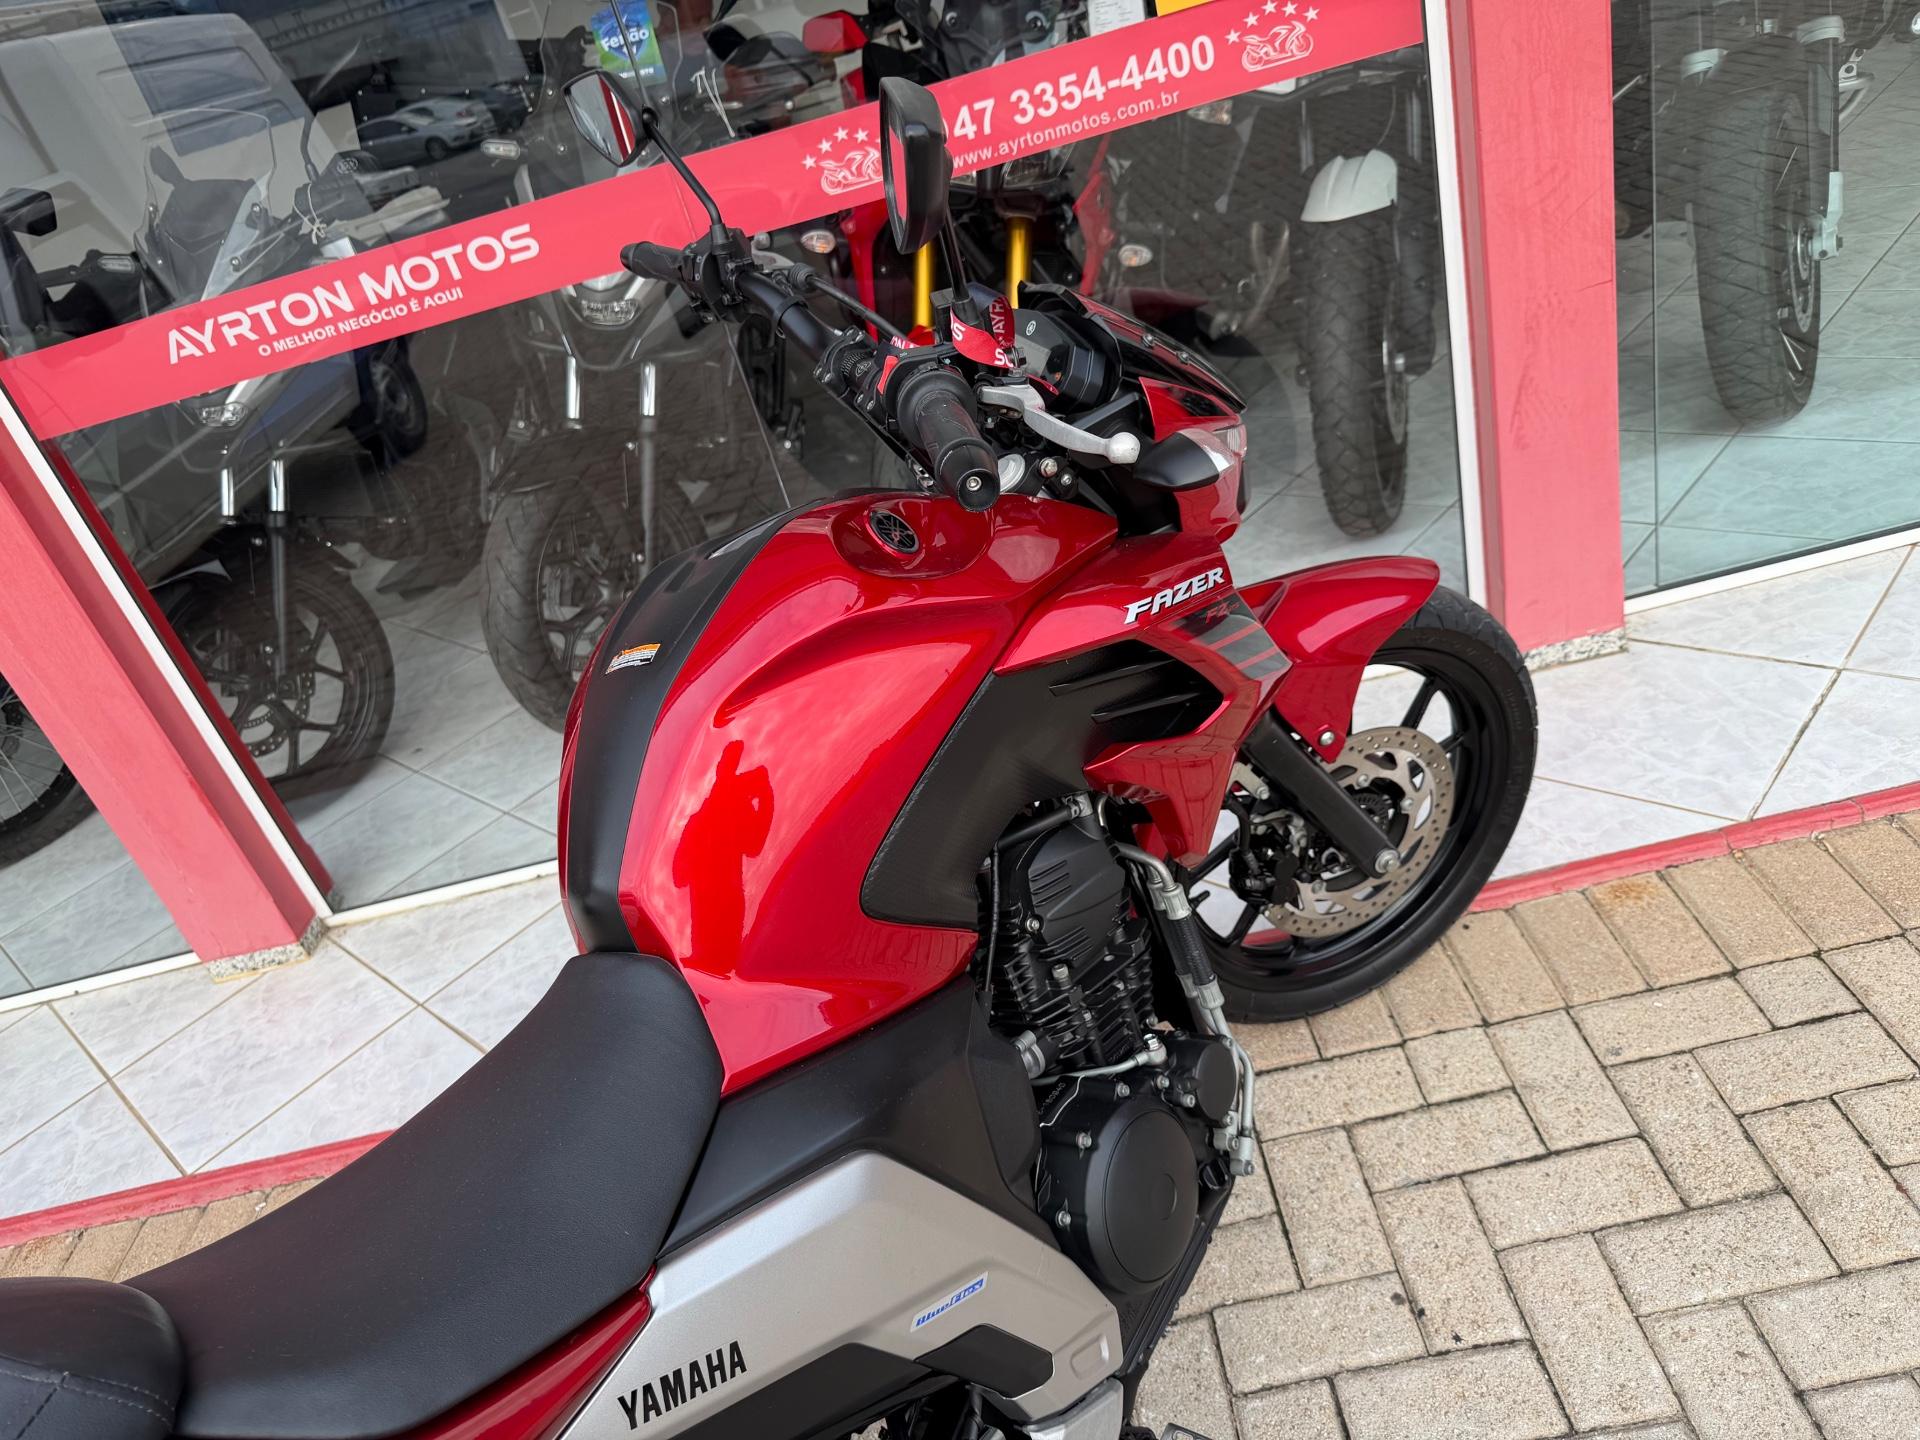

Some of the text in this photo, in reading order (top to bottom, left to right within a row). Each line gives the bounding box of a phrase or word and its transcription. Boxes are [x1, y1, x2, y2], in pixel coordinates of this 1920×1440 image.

[942, 34, 1216, 140] 47 3354-4400
[953, 88, 1180, 169] www.ayrtonmotos.com.br
[168, 222, 540, 365] AYRTON MOTOS
[258, 286, 464, 358] O MELHOR NEGÓCIO É AQUI
[1123, 566, 1225, 625] FAZER
[616, 1340, 748, 1431] YAMAHA
